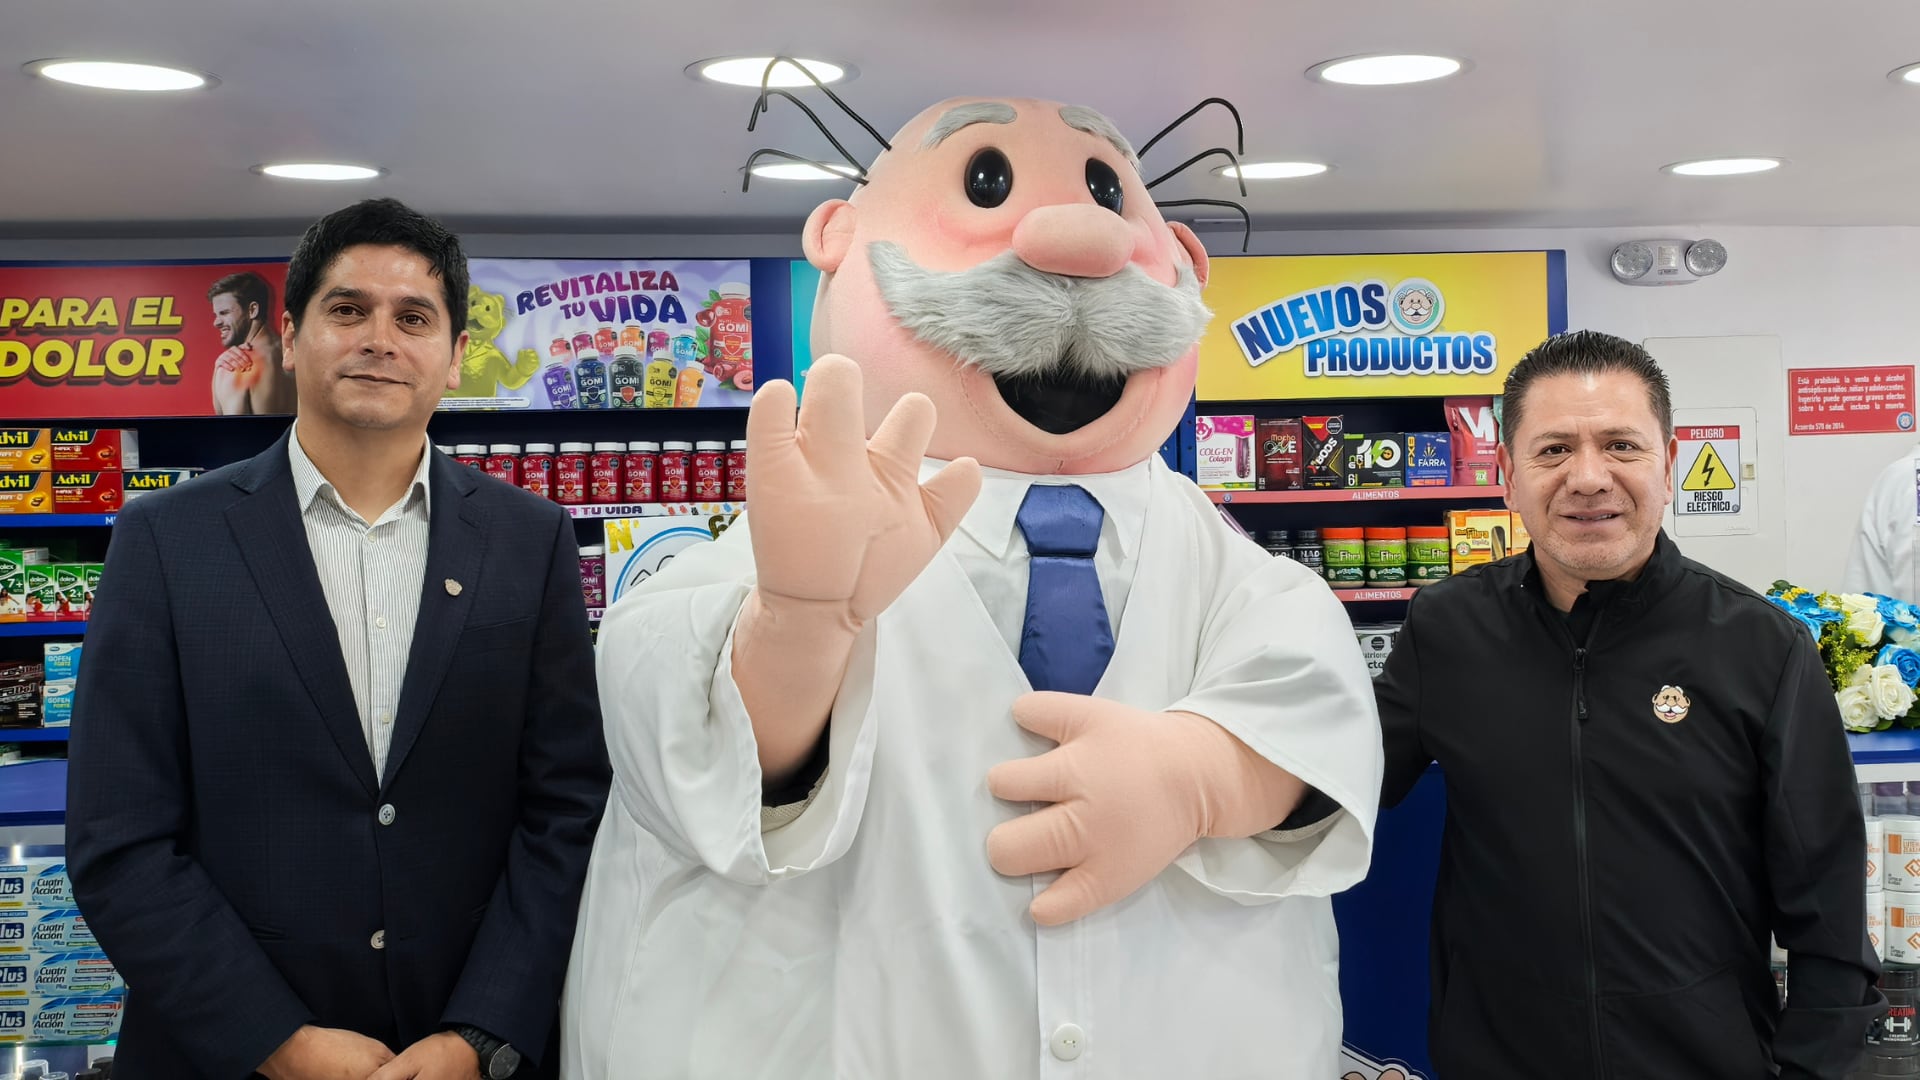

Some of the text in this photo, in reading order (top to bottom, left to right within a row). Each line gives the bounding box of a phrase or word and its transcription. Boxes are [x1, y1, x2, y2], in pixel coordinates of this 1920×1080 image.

[516, 270, 680, 315] REVITALIZA
[1, 297, 183, 328] PARA EL
[560, 294, 688, 324] TU VIDA
[718, 323, 749, 332] GOMI
[1236, 283, 1387, 361] NUEVOS
[0, 338, 185, 378] DOLOR
[1307, 335, 1494, 372] PRODUCTOS
[581, 377, 603, 386] GOMI
[615, 377, 639, 385] GOMI
[650, 379, 672, 387] GOMI
[0, 431, 29, 445] dvil
[54, 430, 89, 442] Advil
[1690, 428, 1724, 439] PELIGRO
[1418, 458, 1447, 467] FARRA
[0, 475, 30, 488] dvil
[56, 474, 91, 485] Advil
[128, 474, 171, 488] Advil
[1352, 490, 1400, 500] ALIMENTOS
[1694, 491, 1723, 502] RIESGO
[605, 506, 642, 514] VIDA
[1687, 501, 1731, 512] ELECTRICO
[1355, 591, 1402, 600] ALIMENTOS
[37, 877, 64, 888] Cuatri
[37, 923, 65, 933] Cuatri
[40, 966, 67, 976] Cuatri
[38, 1011, 66, 1021] Cuatri
